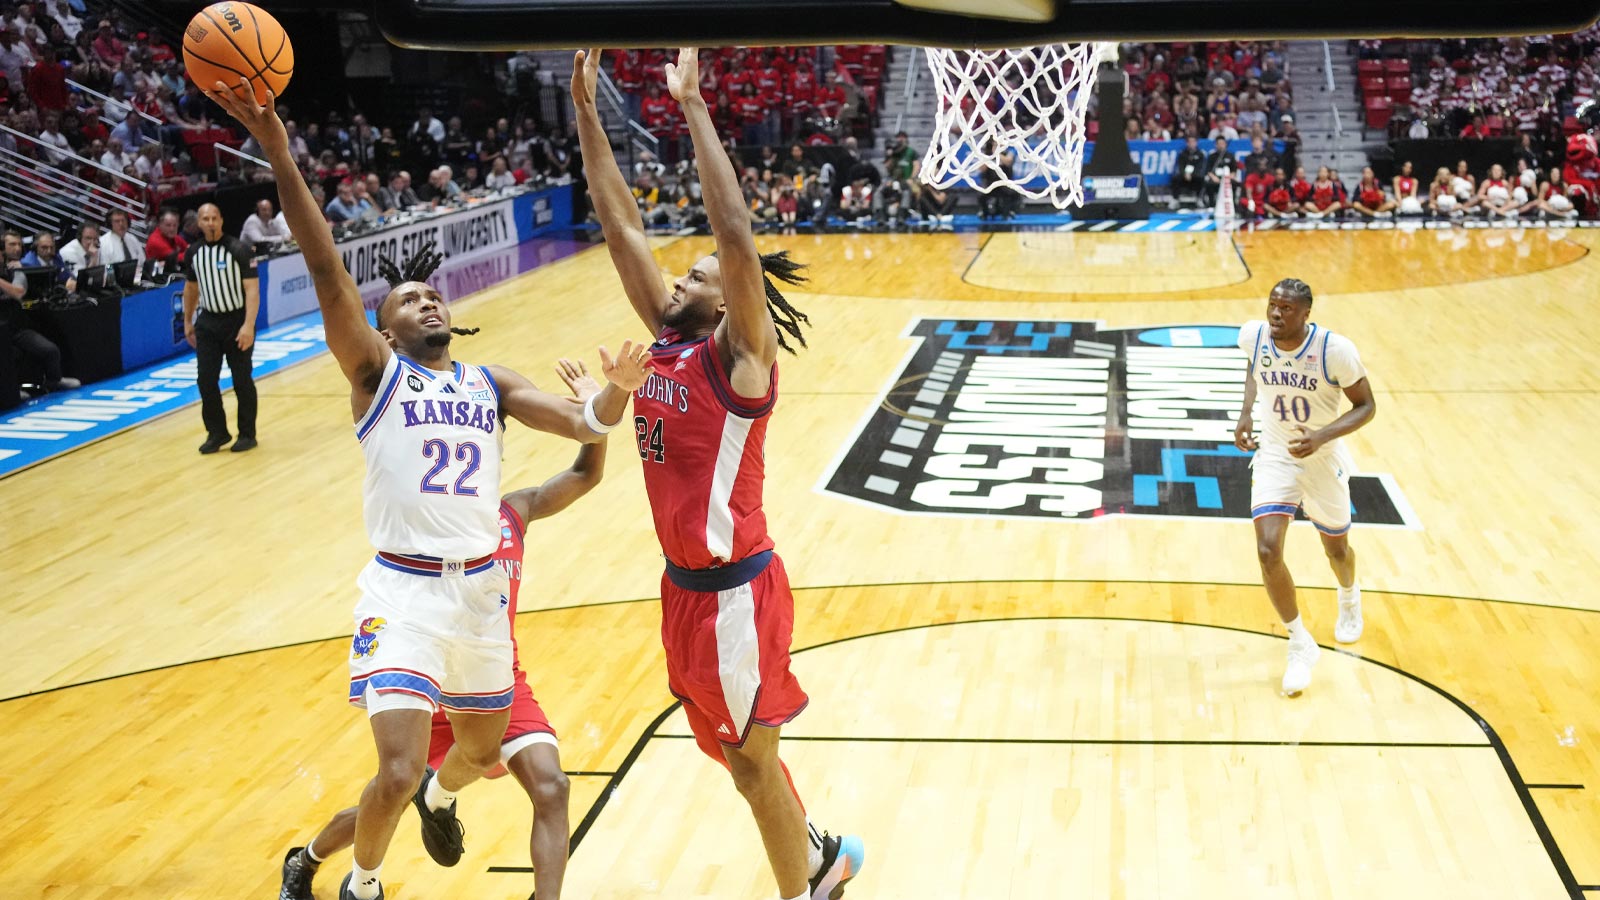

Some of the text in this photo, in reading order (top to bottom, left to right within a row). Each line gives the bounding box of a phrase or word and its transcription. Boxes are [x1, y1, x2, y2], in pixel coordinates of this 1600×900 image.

[356, 238, 398, 286] DIEGO
[402, 226, 438, 268] STATE
[443, 208, 509, 259] UNIVERSITY
[408, 375, 422, 391] SW
[1126, 345, 1262, 441] MARCH
[1260, 371, 1318, 391] KANSAS
[400, 399, 496, 434] KANSAS
[1273, 394, 1311, 423] 40
[633, 415, 665, 464] 24
[910, 355, 1110, 513] MADNESS
[420, 438, 481, 497] 22
[447, 562, 461, 572] KU
